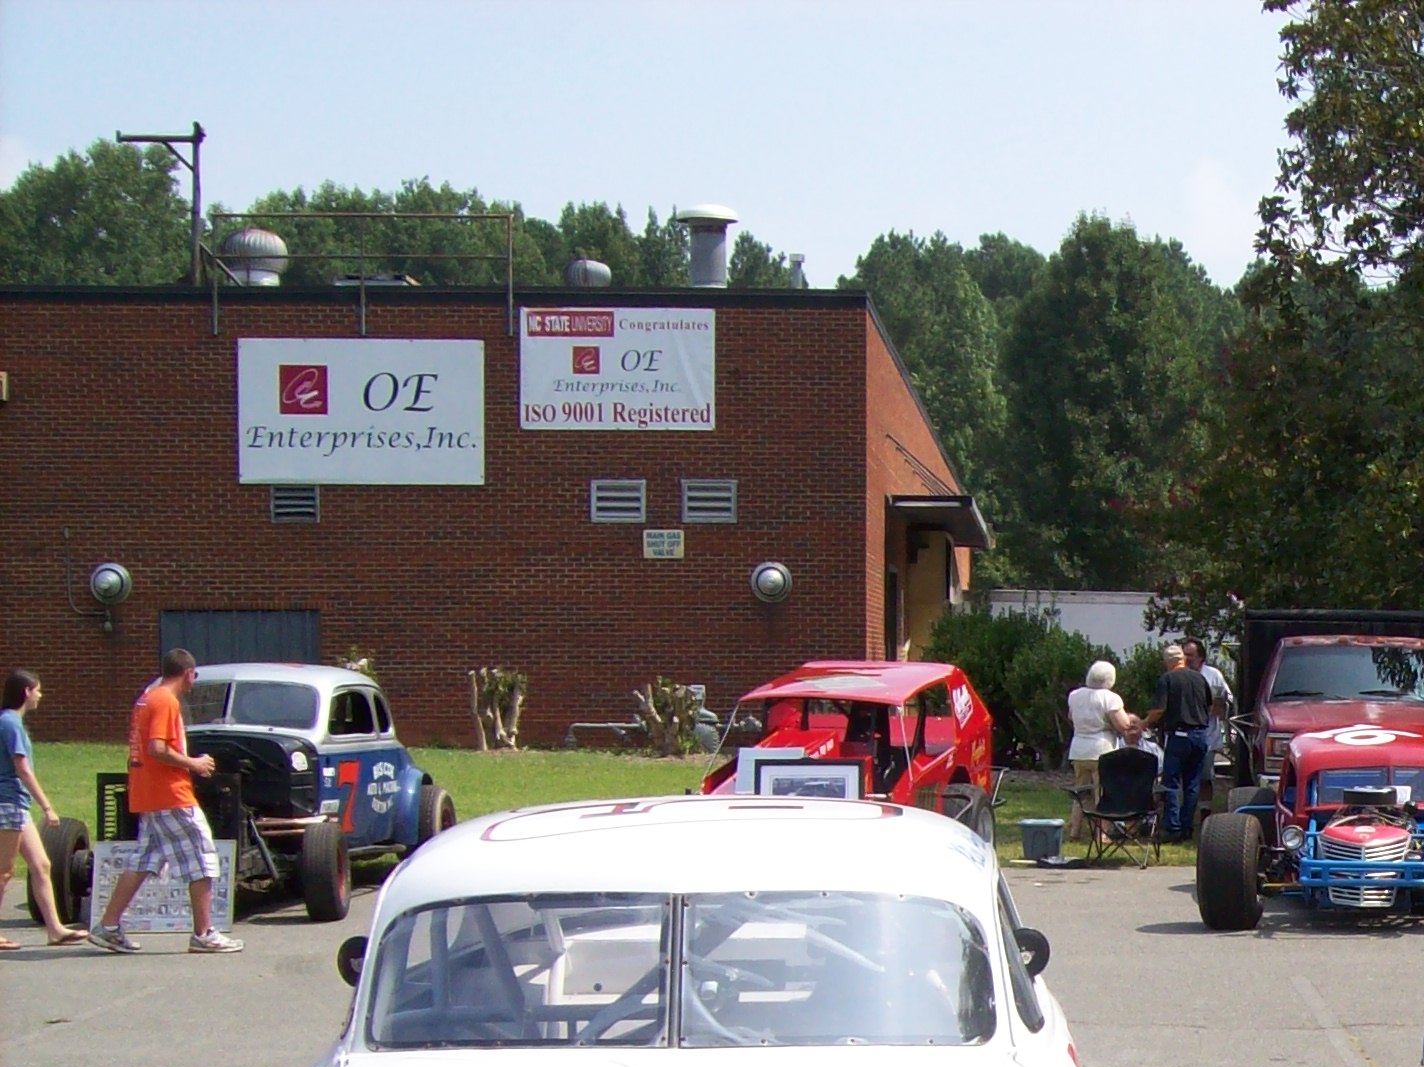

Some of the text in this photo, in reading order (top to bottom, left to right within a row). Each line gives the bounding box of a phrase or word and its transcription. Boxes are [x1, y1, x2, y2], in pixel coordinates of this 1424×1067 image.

[528, 315, 612, 333] NC STATE UNIVERSITY
[619, 318, 709, 332] Congratulates
[620, 348, 663, 372] OE
[362, 372, 439, 413] OE
[524, 401, 711, 428] ISO 9001 Registered
[336, 758, 361, 833] 7
